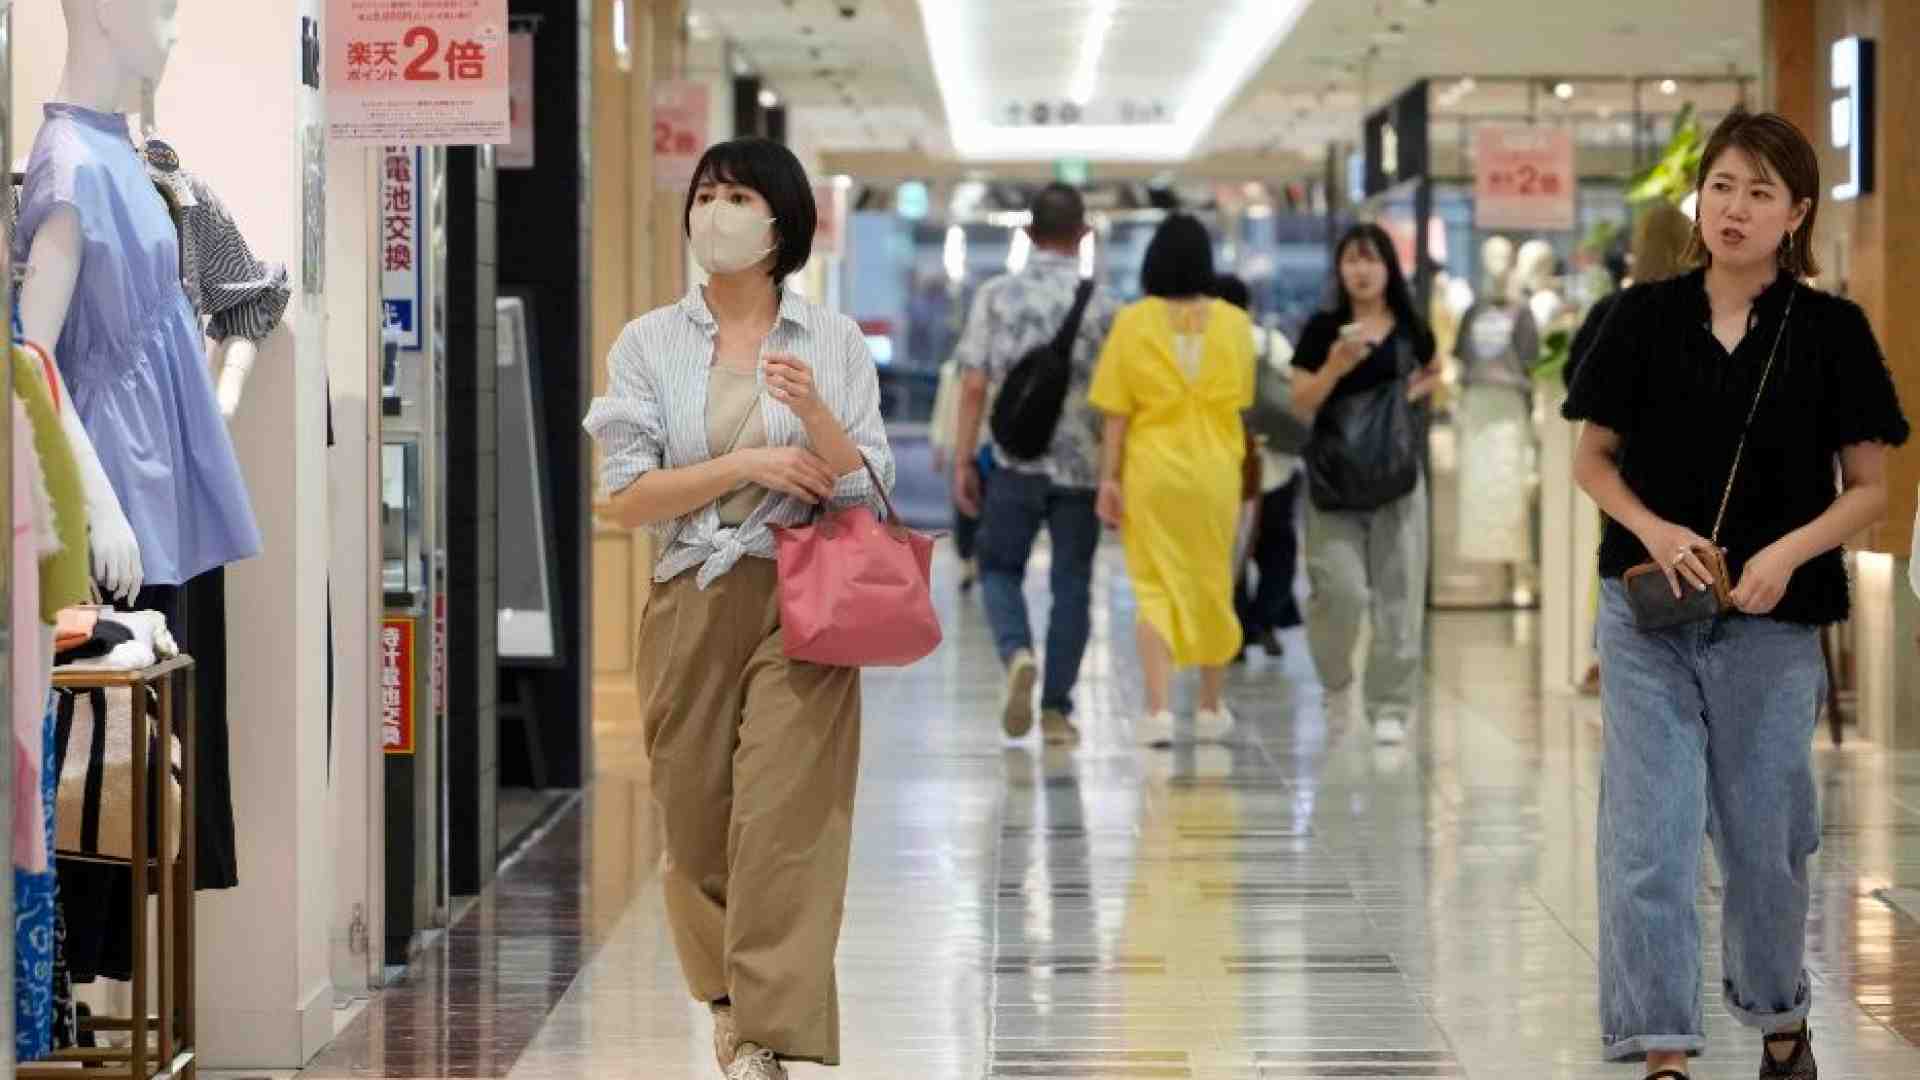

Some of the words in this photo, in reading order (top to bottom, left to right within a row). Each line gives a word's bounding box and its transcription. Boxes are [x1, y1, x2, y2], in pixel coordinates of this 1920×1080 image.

[347, 40, 398, 65] 楽天
[403, 26, 486, 81] 2倍
[347, 68, 399, 81] ポイント
[385, 145, 412, 272] 電池交換
